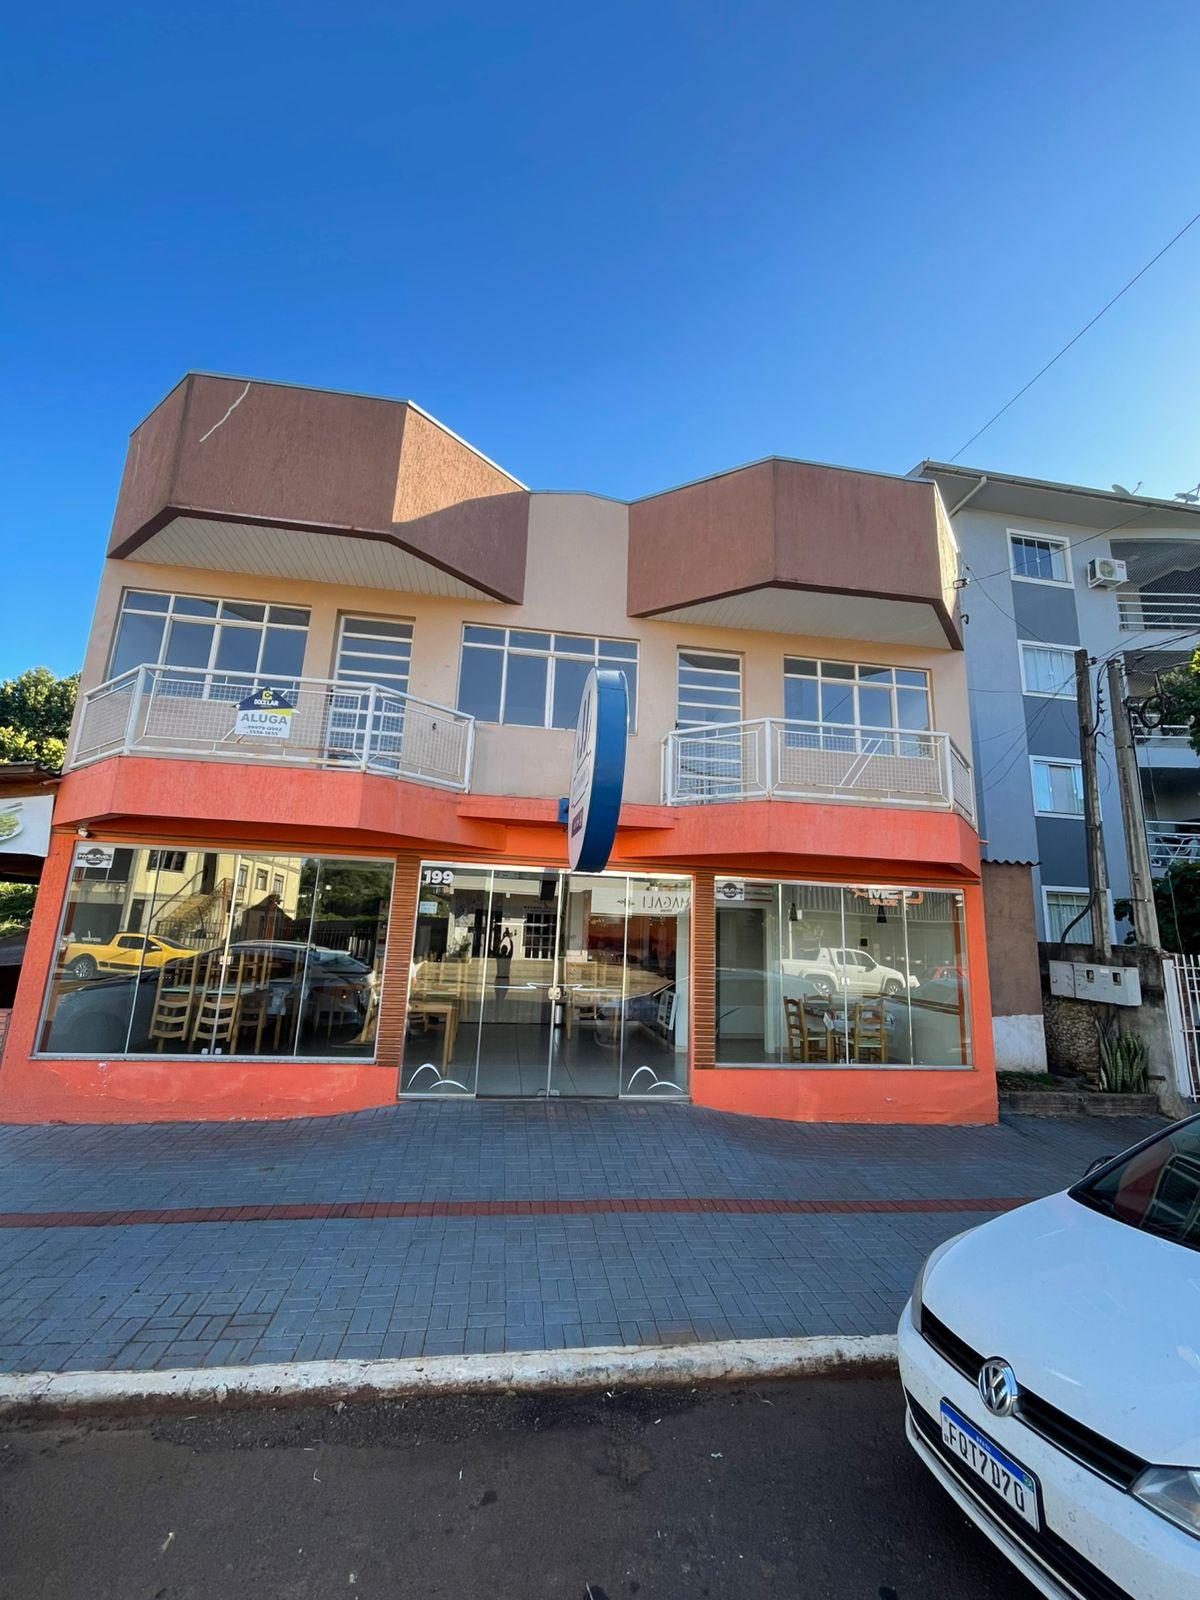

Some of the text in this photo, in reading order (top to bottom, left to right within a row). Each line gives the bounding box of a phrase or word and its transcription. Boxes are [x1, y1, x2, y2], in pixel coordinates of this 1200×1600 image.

[241, 713, 288, 725] ALUGA
[424, 870, 454, 884] 199
[948, 1421, 1025, 1513] FQT7D70
